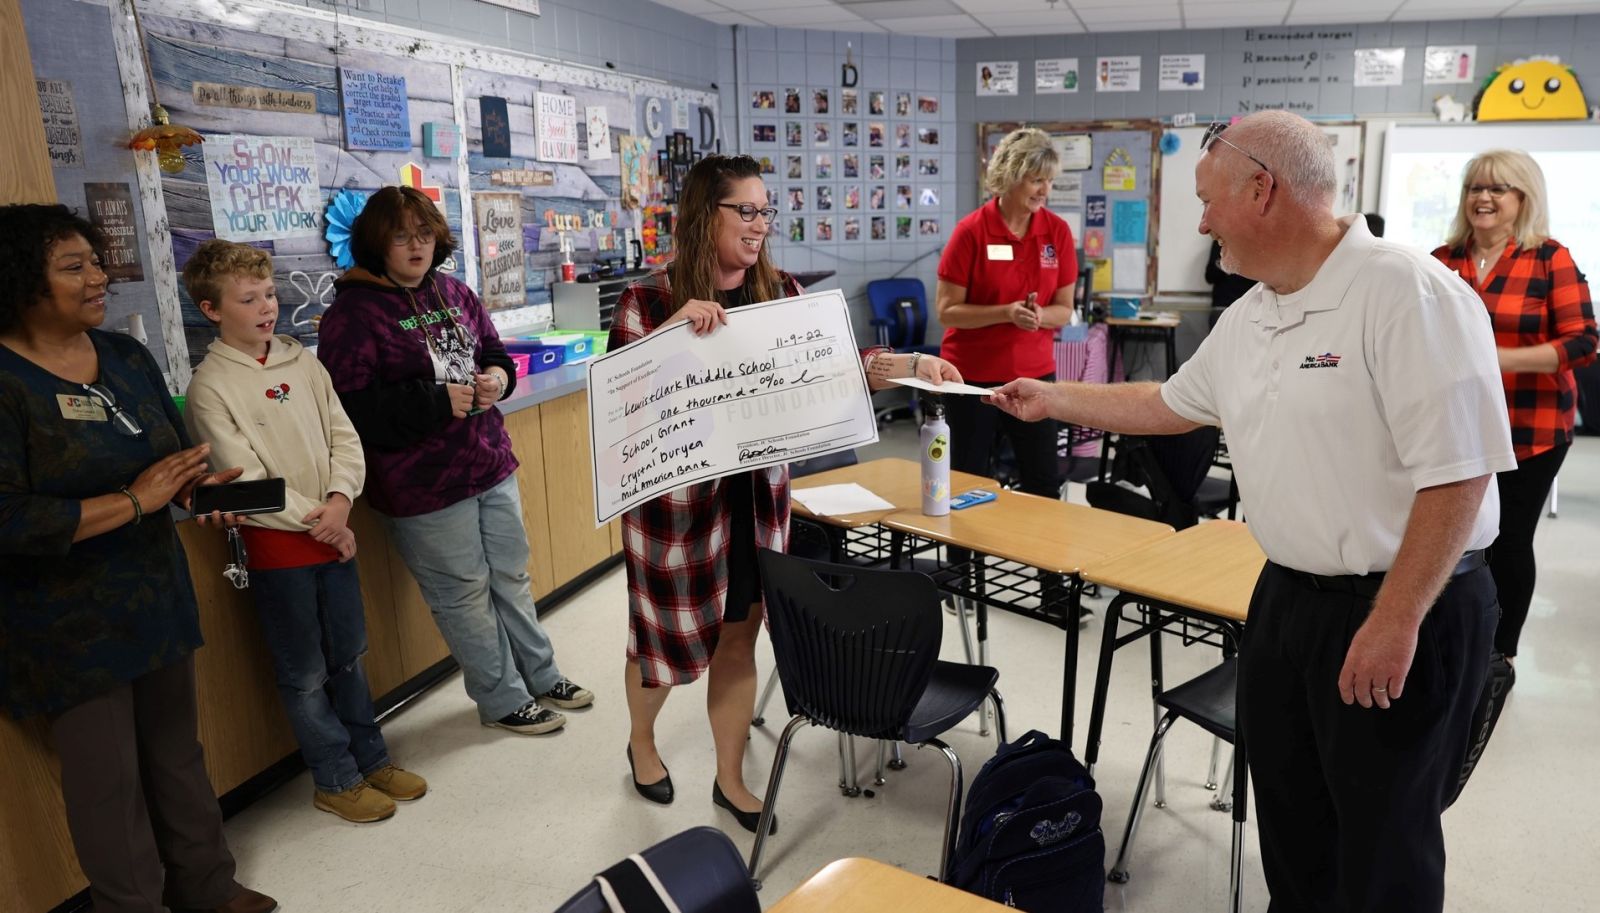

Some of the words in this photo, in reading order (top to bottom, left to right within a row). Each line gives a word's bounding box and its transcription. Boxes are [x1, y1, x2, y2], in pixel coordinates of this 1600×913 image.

[37, 81, 47, 93] OU
[343, 69, 365, 80] Want
[841, 64, 858, 87] D
[541, 95, 574, 117] HOME
[643, 97, 664, 140] C
[698, 106, 716, 150] D
[48, 147, 77, 164] hings
[233, 138, 291, 170] SHOW
[213, 160, 262, 185] YOUR
[265, 163, 312, 185] WORK
[229, 182, 305, 216] CHECK
[222, 208, 268, 233] YOUR
[272, 208, 318, 231] WORK
[482, 208, 515, 234] Love
[543, 208, 582, 233] Turn
[485, 250, 522, 279] CLASSROOM
[806, 346, 833, 362] 1,000
[685, 367, 735, 388] Middle
[738, 356, 775, 376] School
[661, 406, 679, 421] one
[686, 386, 746, 409] thousand
[622, 434, 653, 464] School
[658, 417, 696, 439] Grant
[621, 458, 656, 489] Crystal
[660, 440, 704, 464] Duryea
[641, 471, 674, 491] America
[677, 459, 711, 476] Bank
